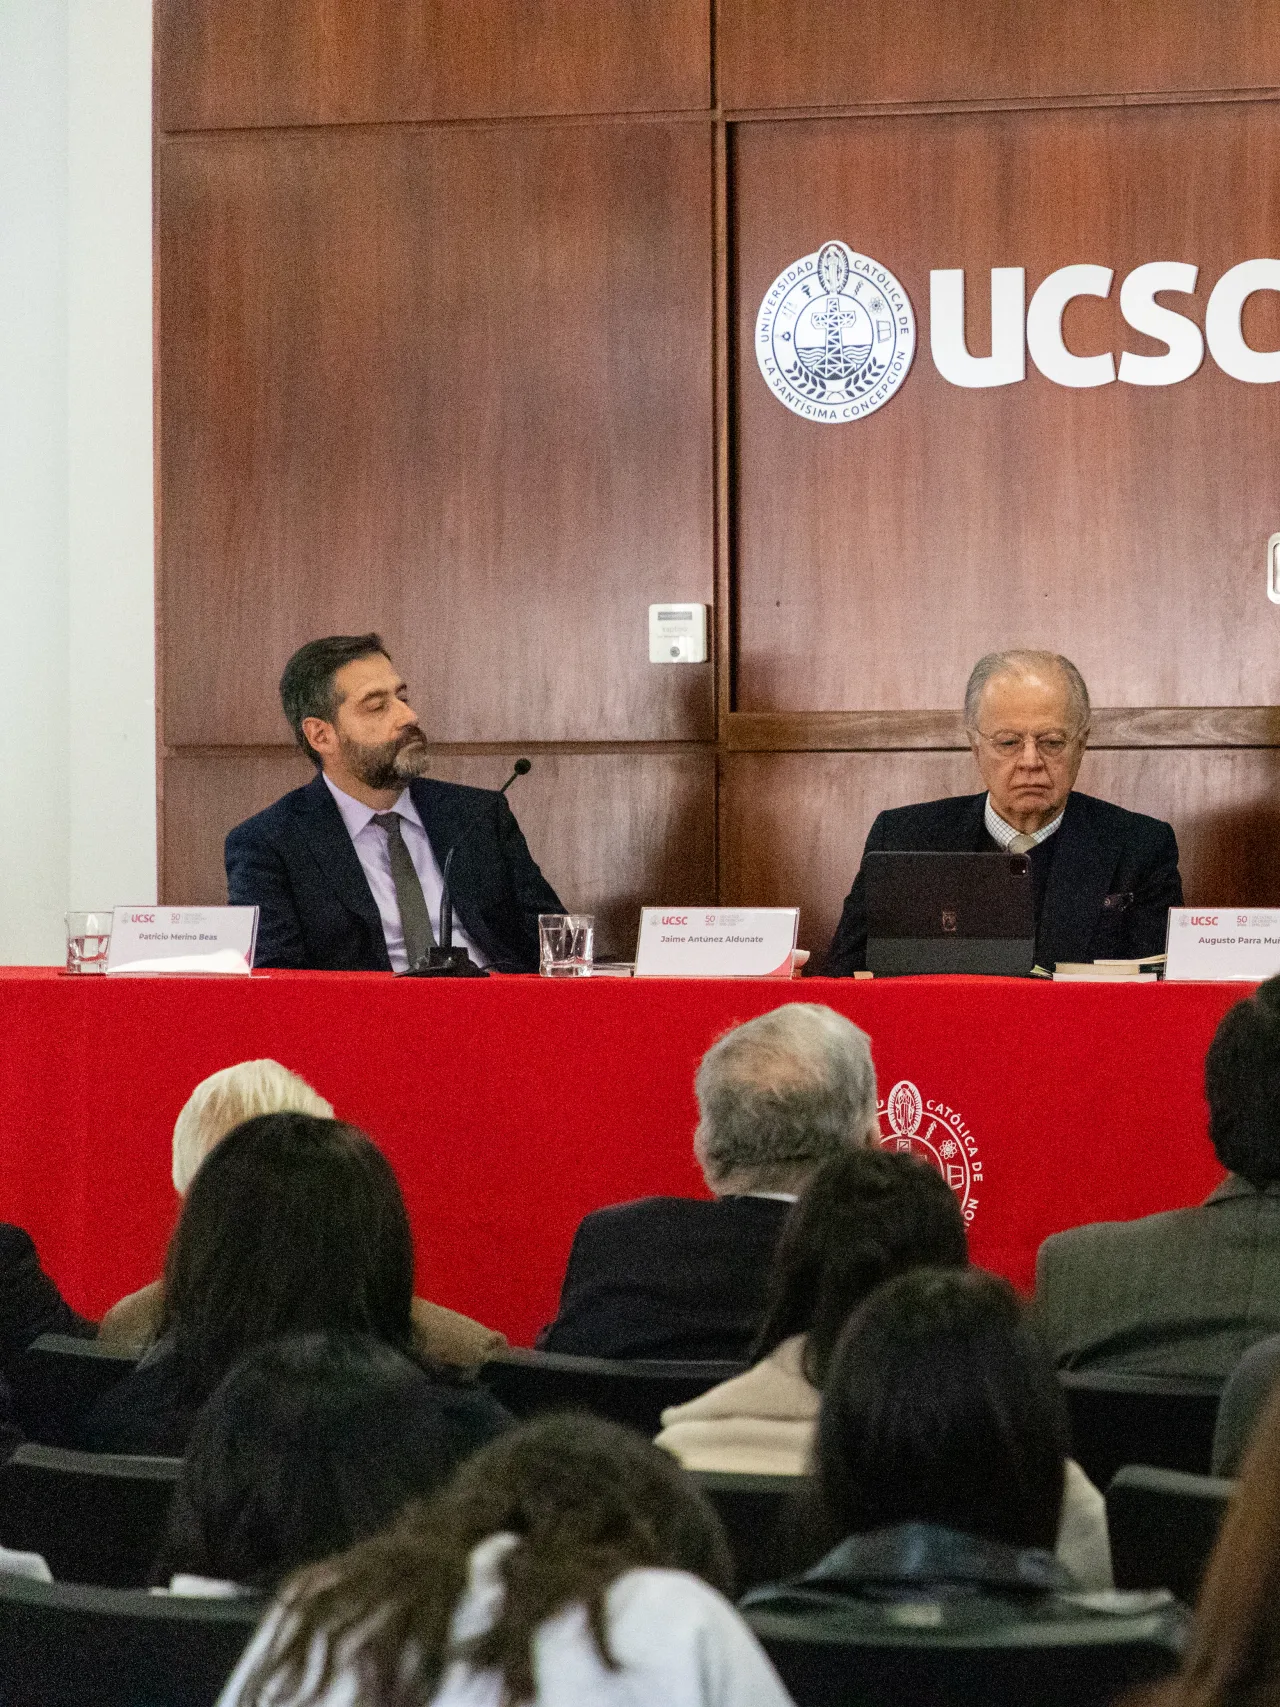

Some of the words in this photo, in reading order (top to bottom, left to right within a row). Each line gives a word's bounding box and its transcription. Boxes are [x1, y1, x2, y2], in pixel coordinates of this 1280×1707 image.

[760, 260, 814, 343] UNIVERSIDAD
[854, 259, 904, 312] CATÓLICA
[898, 316, 910, 335] DE
[764, 356, 775, 376] LA
[773, 378, 838, 419] SANTÍSIMA
[842, 351, 906, 418] CONCEPCIÓN
[131, 913, 155, 923] UCSC
[661, 916, 688, 925] UCSC
[1190, 916, 1219, 926] UCSC
[1236, 915, 1248, 923] 50
[138, 932, 169, 941] Patricio
[170, 933, 197, 941] Merino
[199, 933, 218, 941] Beas
[660, 935, 686, 943] Jaime
[687, 935, 723, 943] Antúnez
[725, 935, 764, 943] Aldunate
[1198, 937, 1236, 945] Augusto
[926, 1099, 979, 1157] CATÓLICA
[971, 1161, 984, 1182] DE
